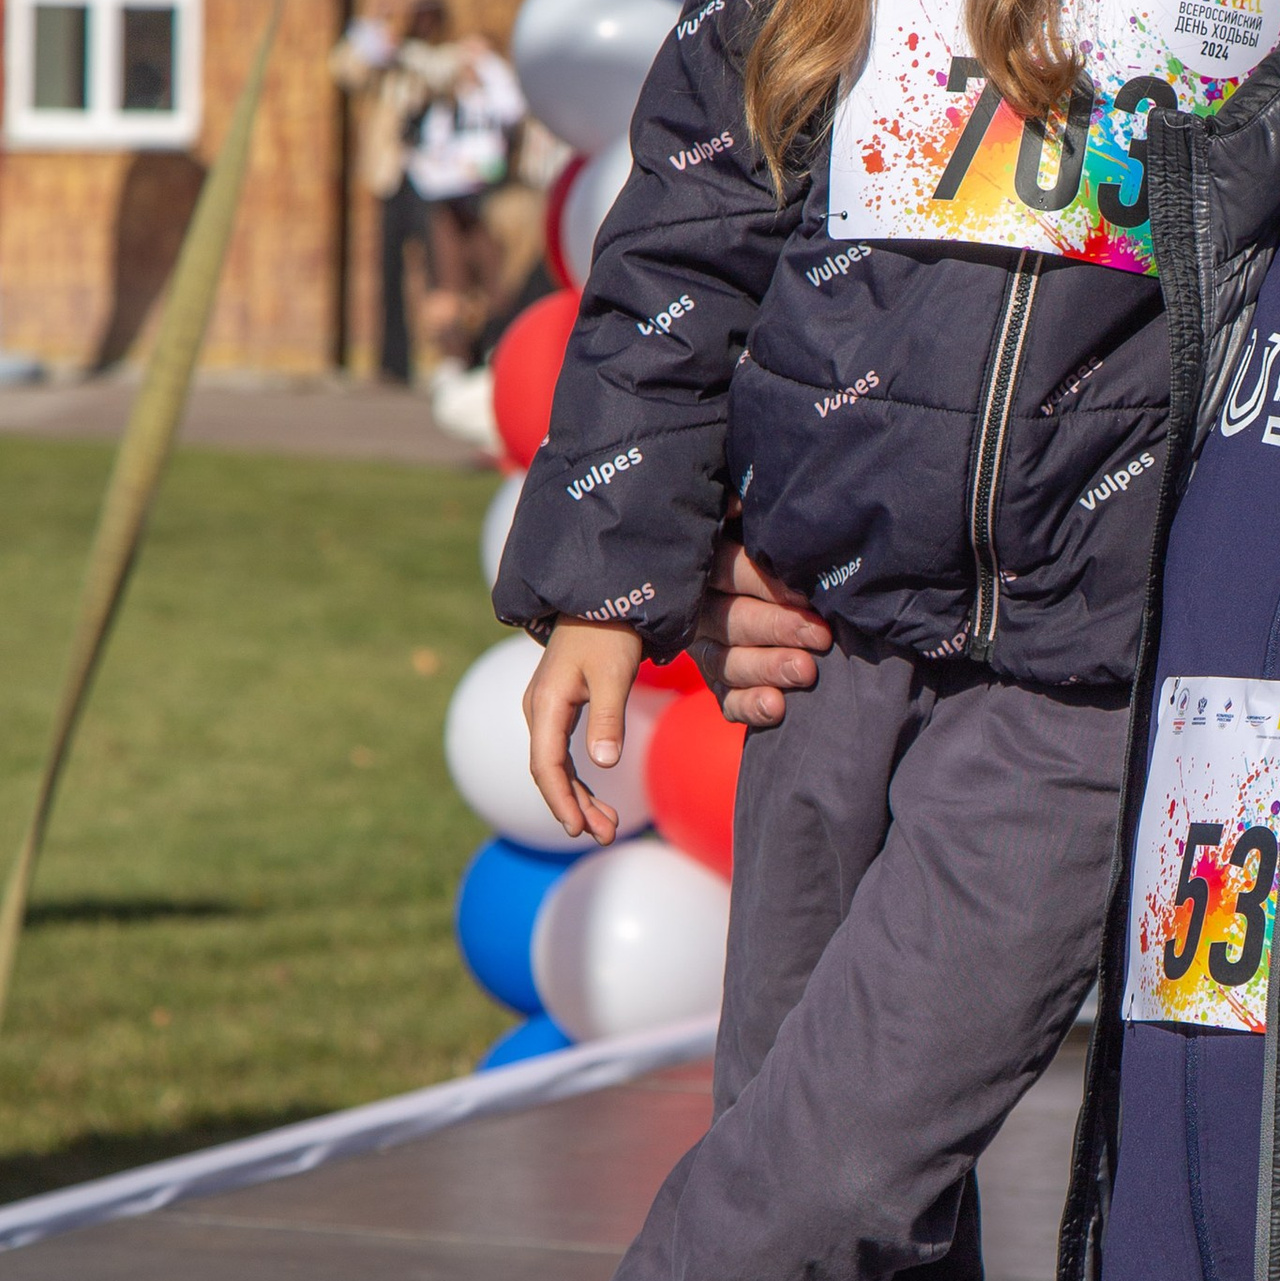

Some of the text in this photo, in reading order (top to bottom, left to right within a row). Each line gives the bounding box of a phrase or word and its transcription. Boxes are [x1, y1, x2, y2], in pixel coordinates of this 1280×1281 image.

[1174, 15, 1260, 48] ДЕНЬ ХОДЬБЫ
[1179, 1, 1263, 31] ВСЕРОССИЙСКИЙ
[1201, 40, 1230, 61] 2024
[668, 130, 735, 171] Vulpes
[932, 56, 1178, 228] 703
[805, 241, 872, 288] Vulpes
[566, 446, 643, 502] Vulpes
[1078, 451, 1156, 512] Vulpes
[1164, 823, 1278, 986] 53
